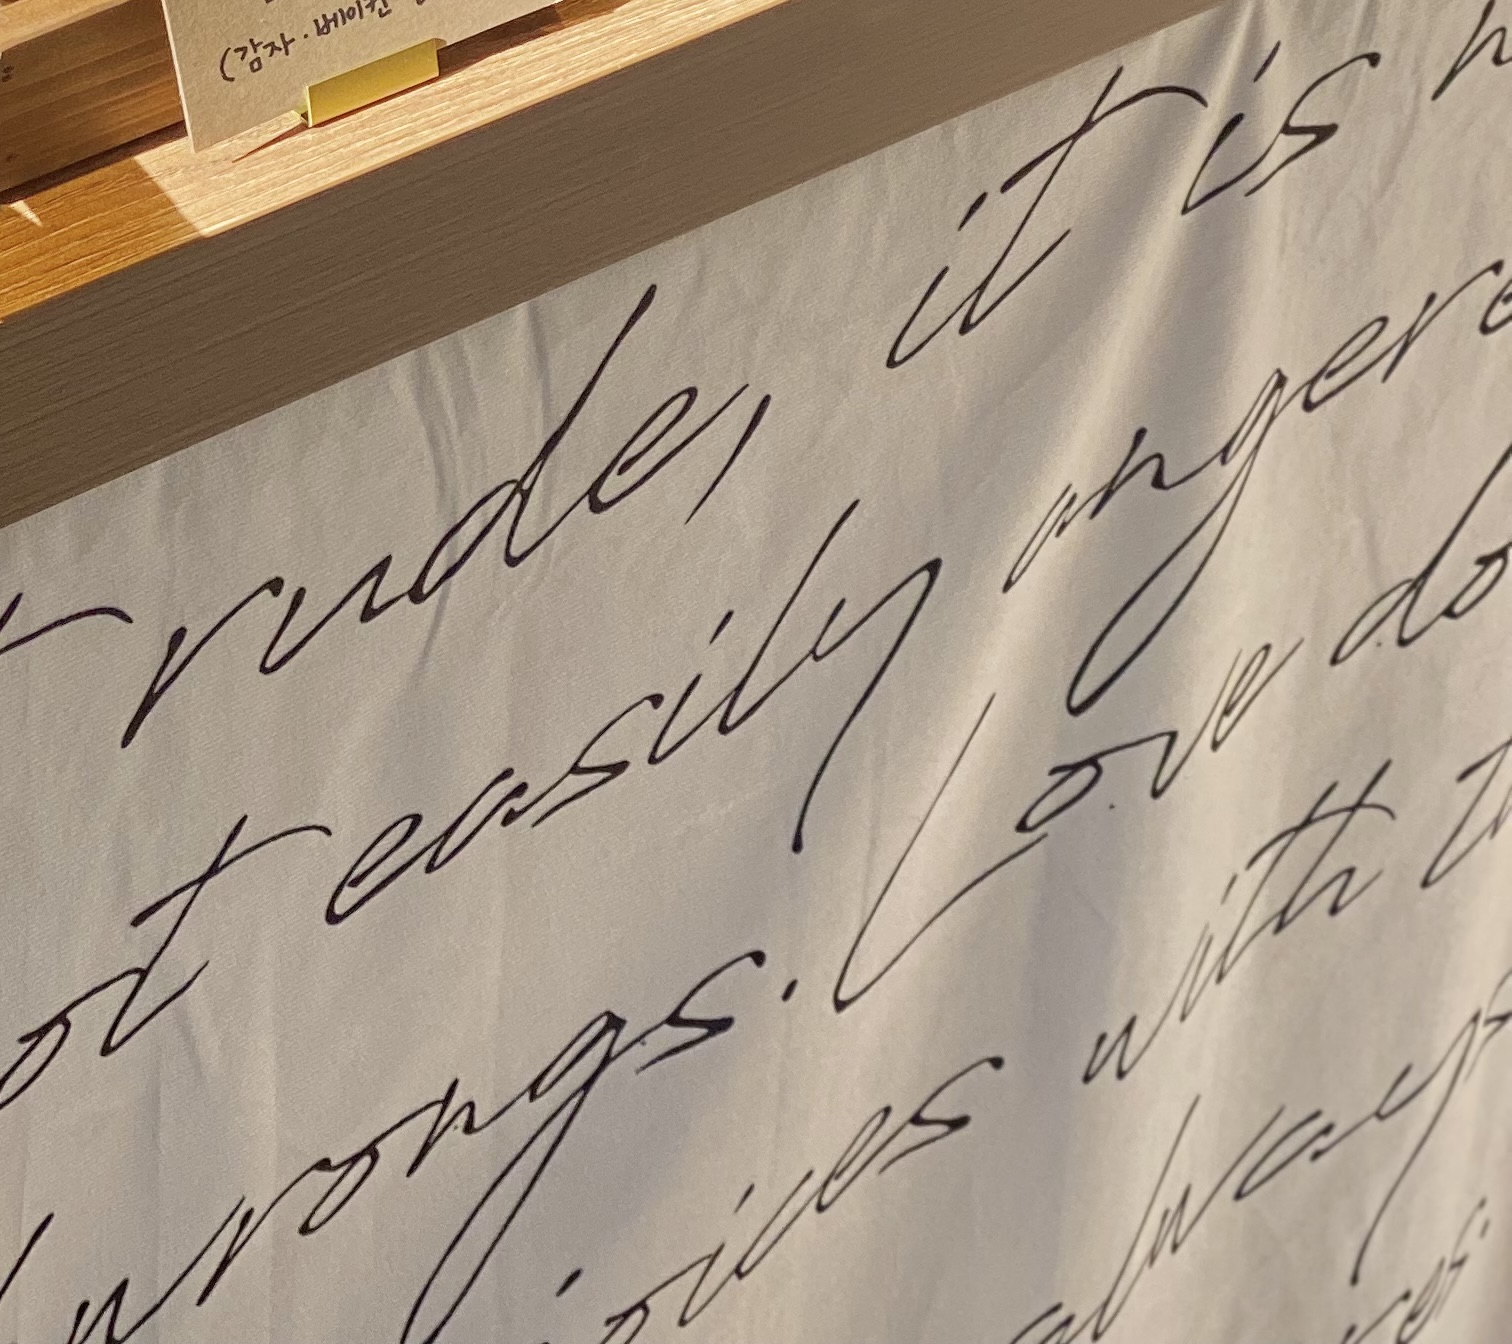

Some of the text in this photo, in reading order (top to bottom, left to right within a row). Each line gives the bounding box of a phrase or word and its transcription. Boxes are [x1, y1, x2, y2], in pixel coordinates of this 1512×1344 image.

[120, 283, 773, 749] rude,
[885, 65, 1209, 369] it
[1180, 40, 1382, 216] is
[324, 498, 943, 854] easily
[832, 638, 1305, 1014] Love
[1081, 758, 1397, 1086] with
